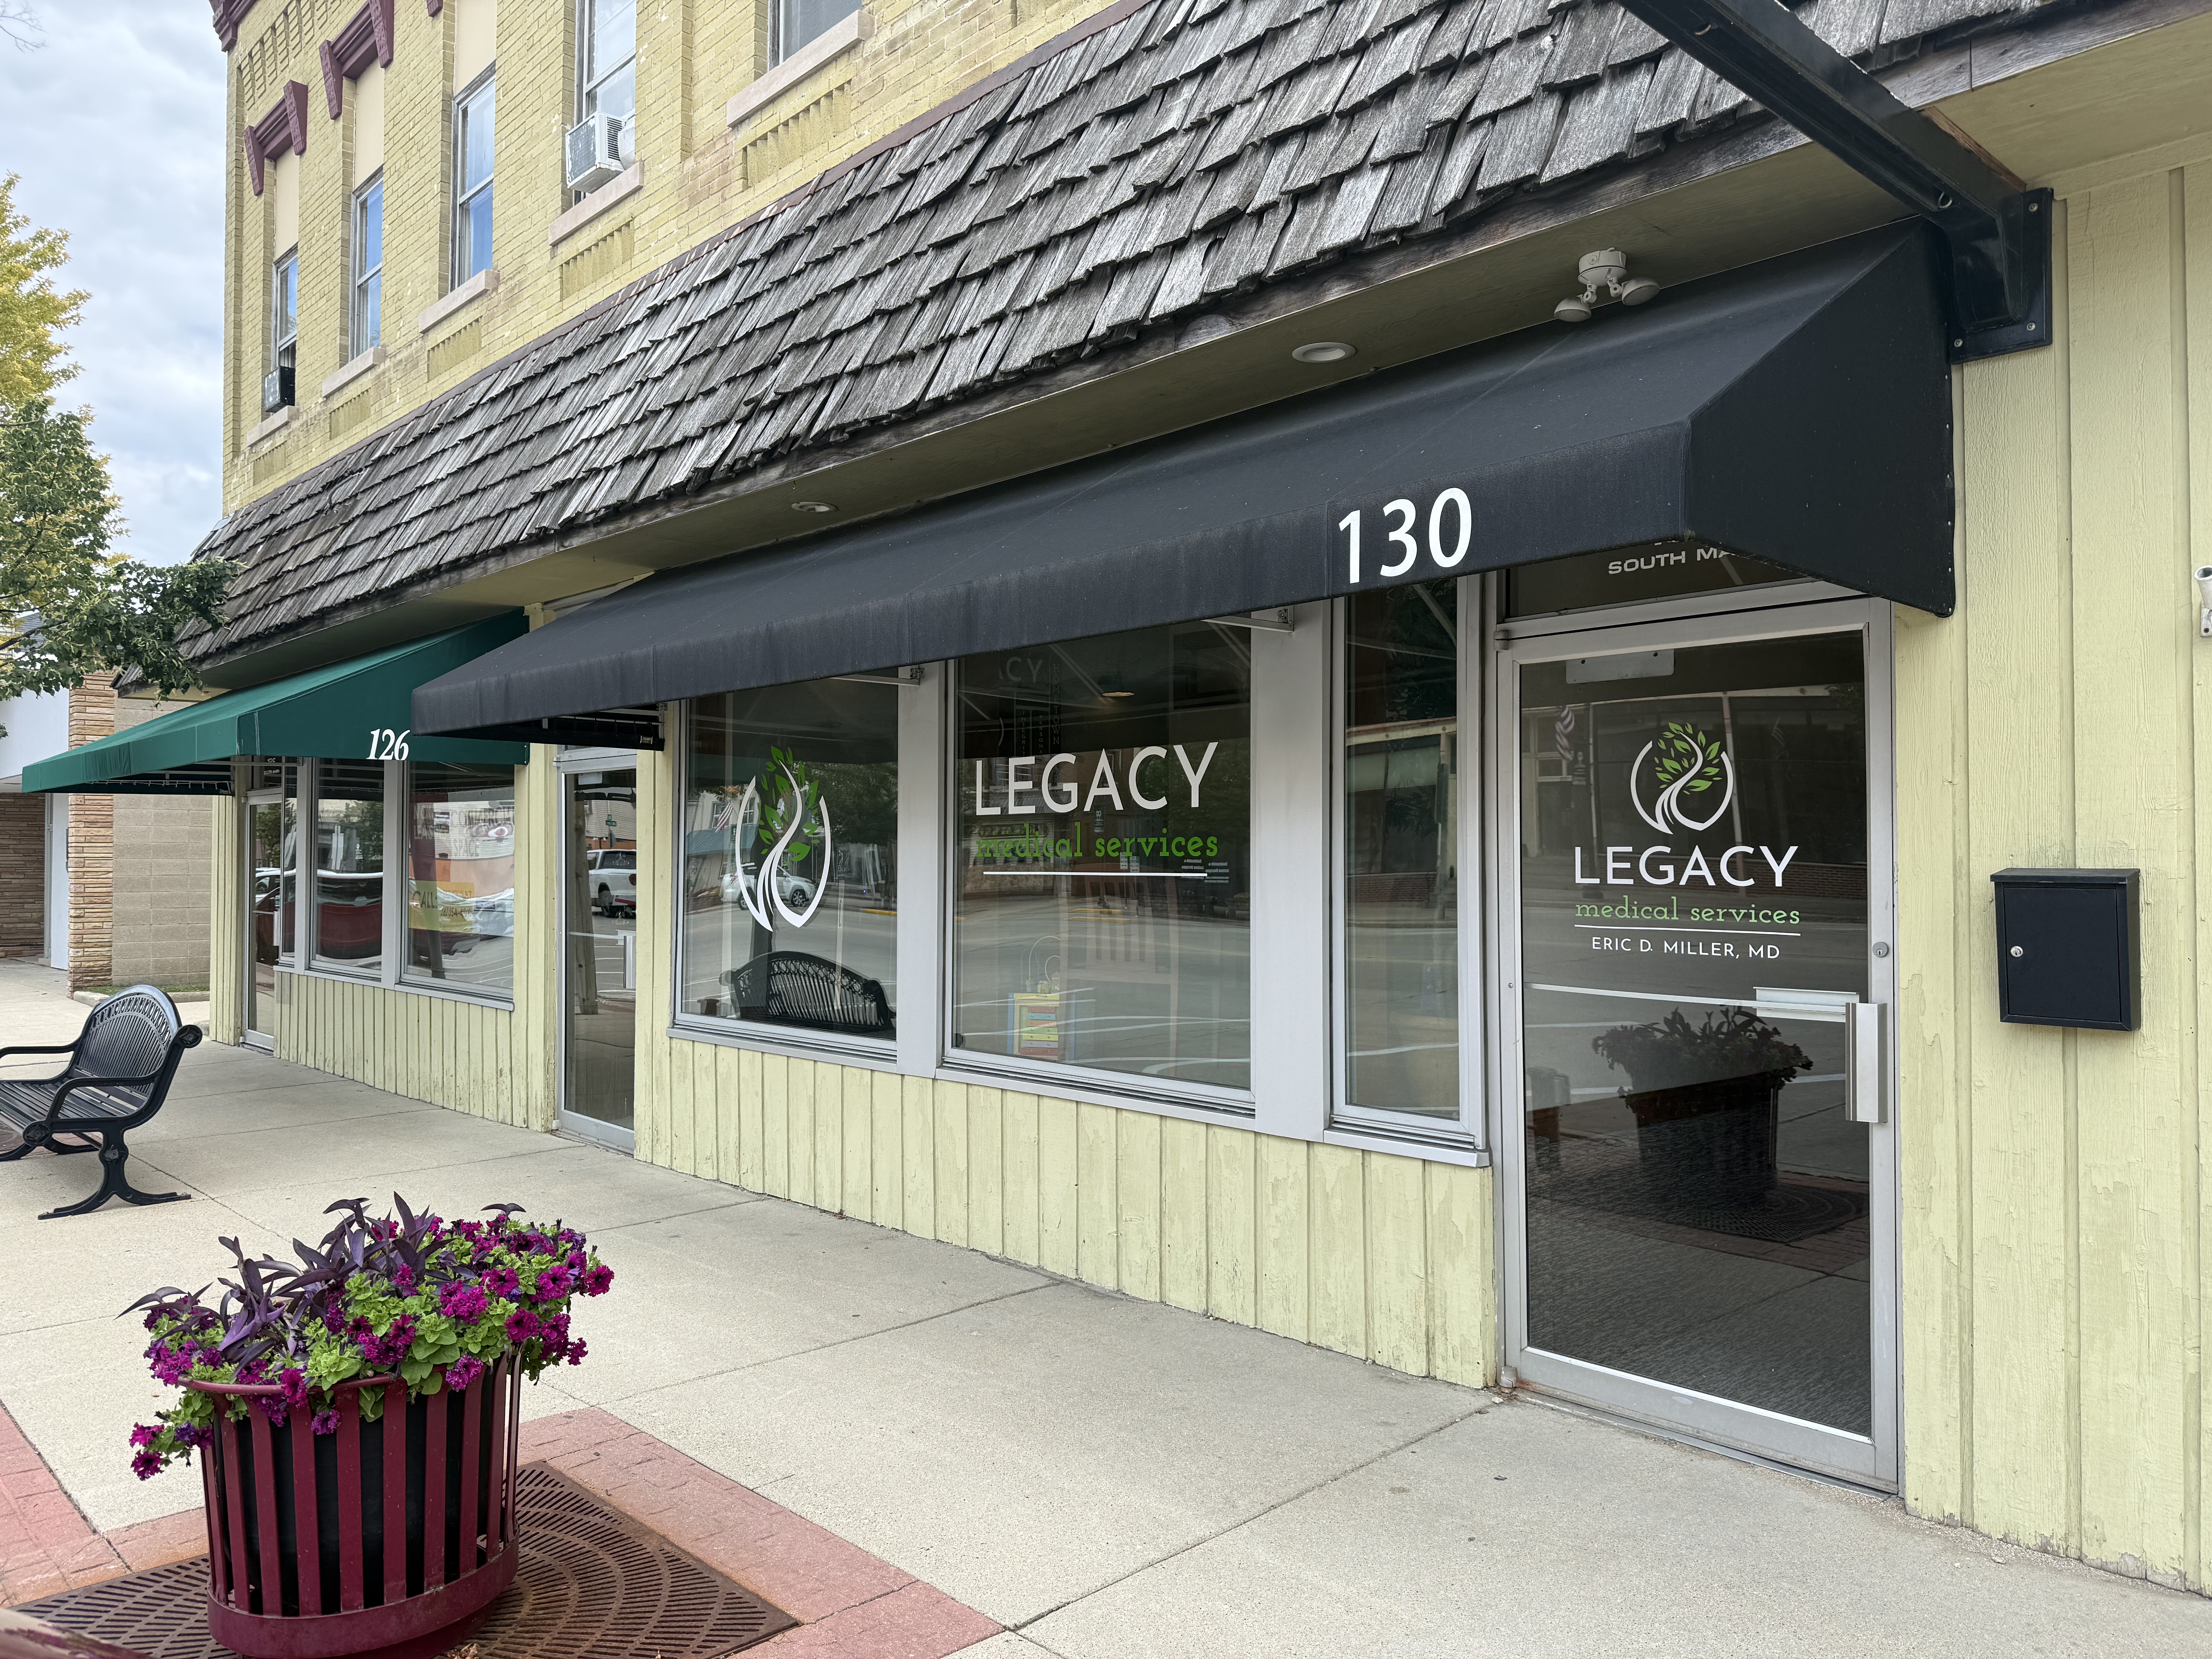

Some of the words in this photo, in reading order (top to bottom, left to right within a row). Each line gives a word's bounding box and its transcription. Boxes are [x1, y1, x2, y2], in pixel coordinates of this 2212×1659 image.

[1338, 488, 1472, 584] 130
[1608, 551, 1686, 574] SOUTH
[999, 656, 1043, 683] CY
[366, 728, 410, 761] 126
[976, 742, 1218, 815] LEGACY
[976, 822, 1083, 857] medical
[1095, 828, 1218, 857] services
[1575, 845, 1798, 887] LEGACY
[1575, 895, 1679, 920] medical
[1690, 904, 1800, 924] services
[1592, 937, 1632, 951] ERIC
[1640, 940, 1653, 952] D.
[1664, 941, 1740, 959] MILLER,
[1749, 945, 1780, 958] MD
